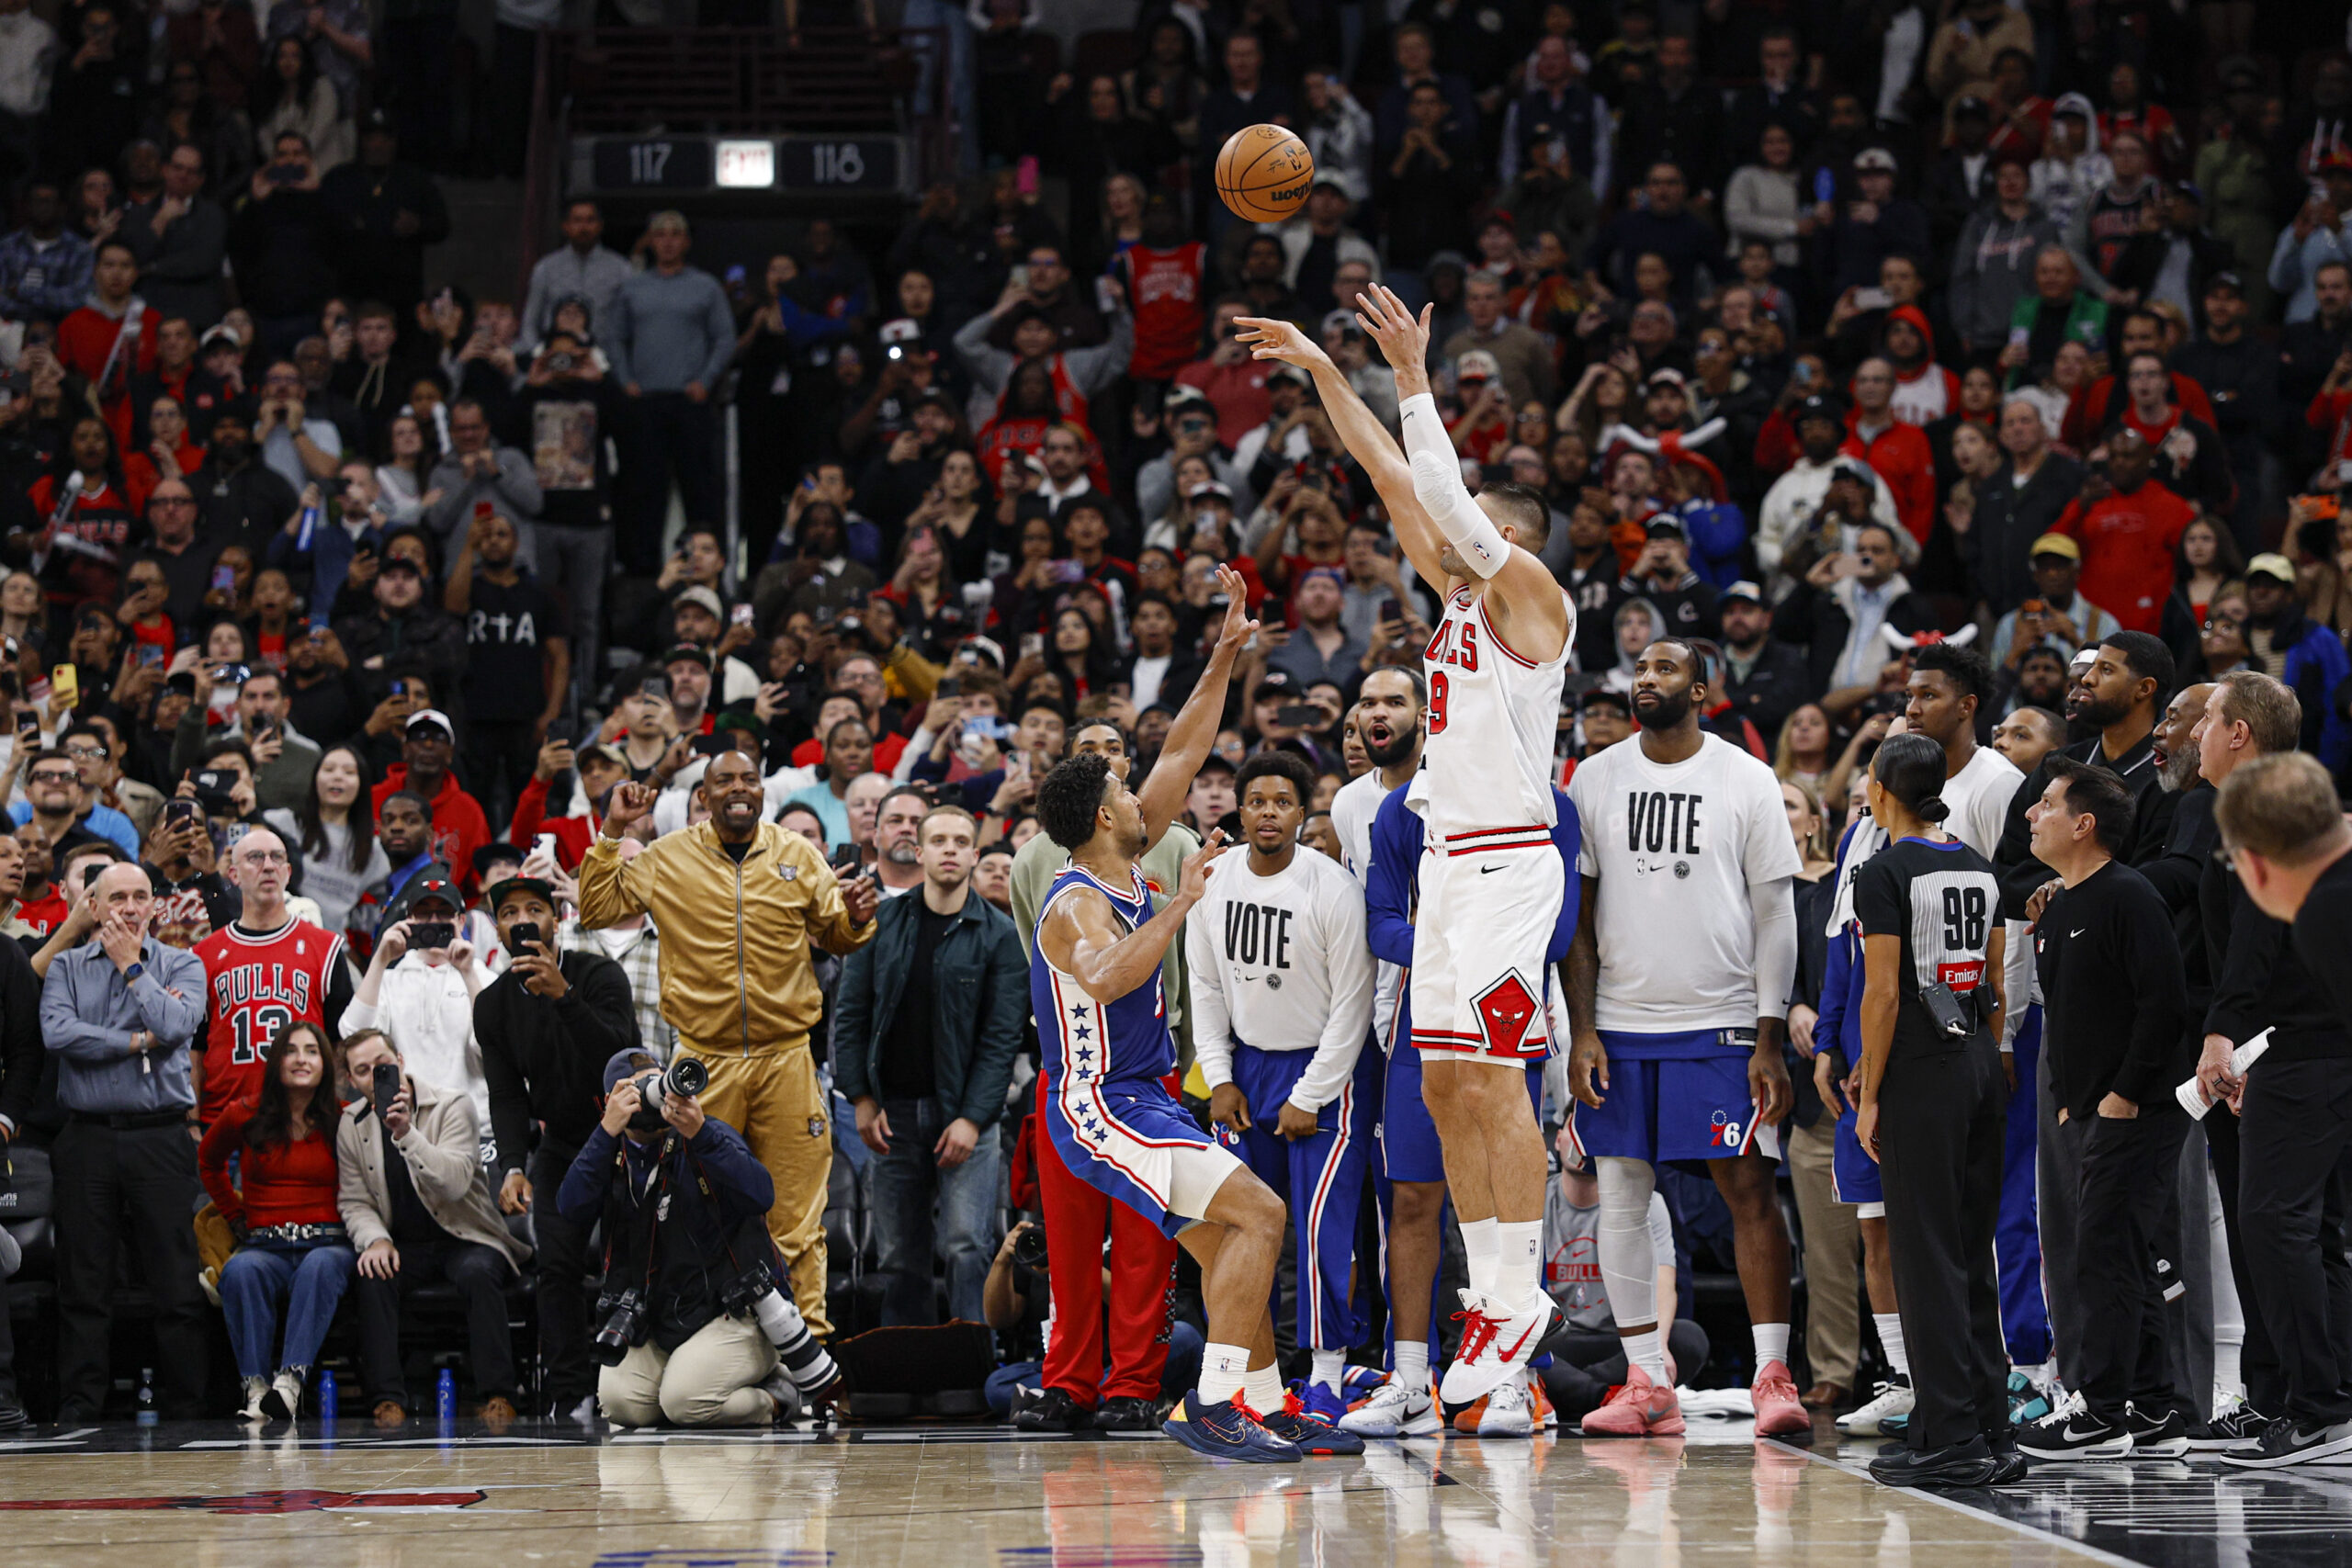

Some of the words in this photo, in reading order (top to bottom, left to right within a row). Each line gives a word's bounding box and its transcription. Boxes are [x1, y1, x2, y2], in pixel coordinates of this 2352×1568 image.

[629, 143, 672, 183] 117
[813, 143, 865, 183] 118
[1429, 671, 1448, 735] 9
[1628, 792, 1702, 855] VOTE
[1225, 900, 1293, 969] VOTE
[1942, 886, 1985, 951] 98
[214, 963, 310, 1020] BULLS
[232, 1004, 292, 1066] 13
[1711, 1122, 1741, 1147] 76
[1556, 1264, 1601, 1280] BULL
